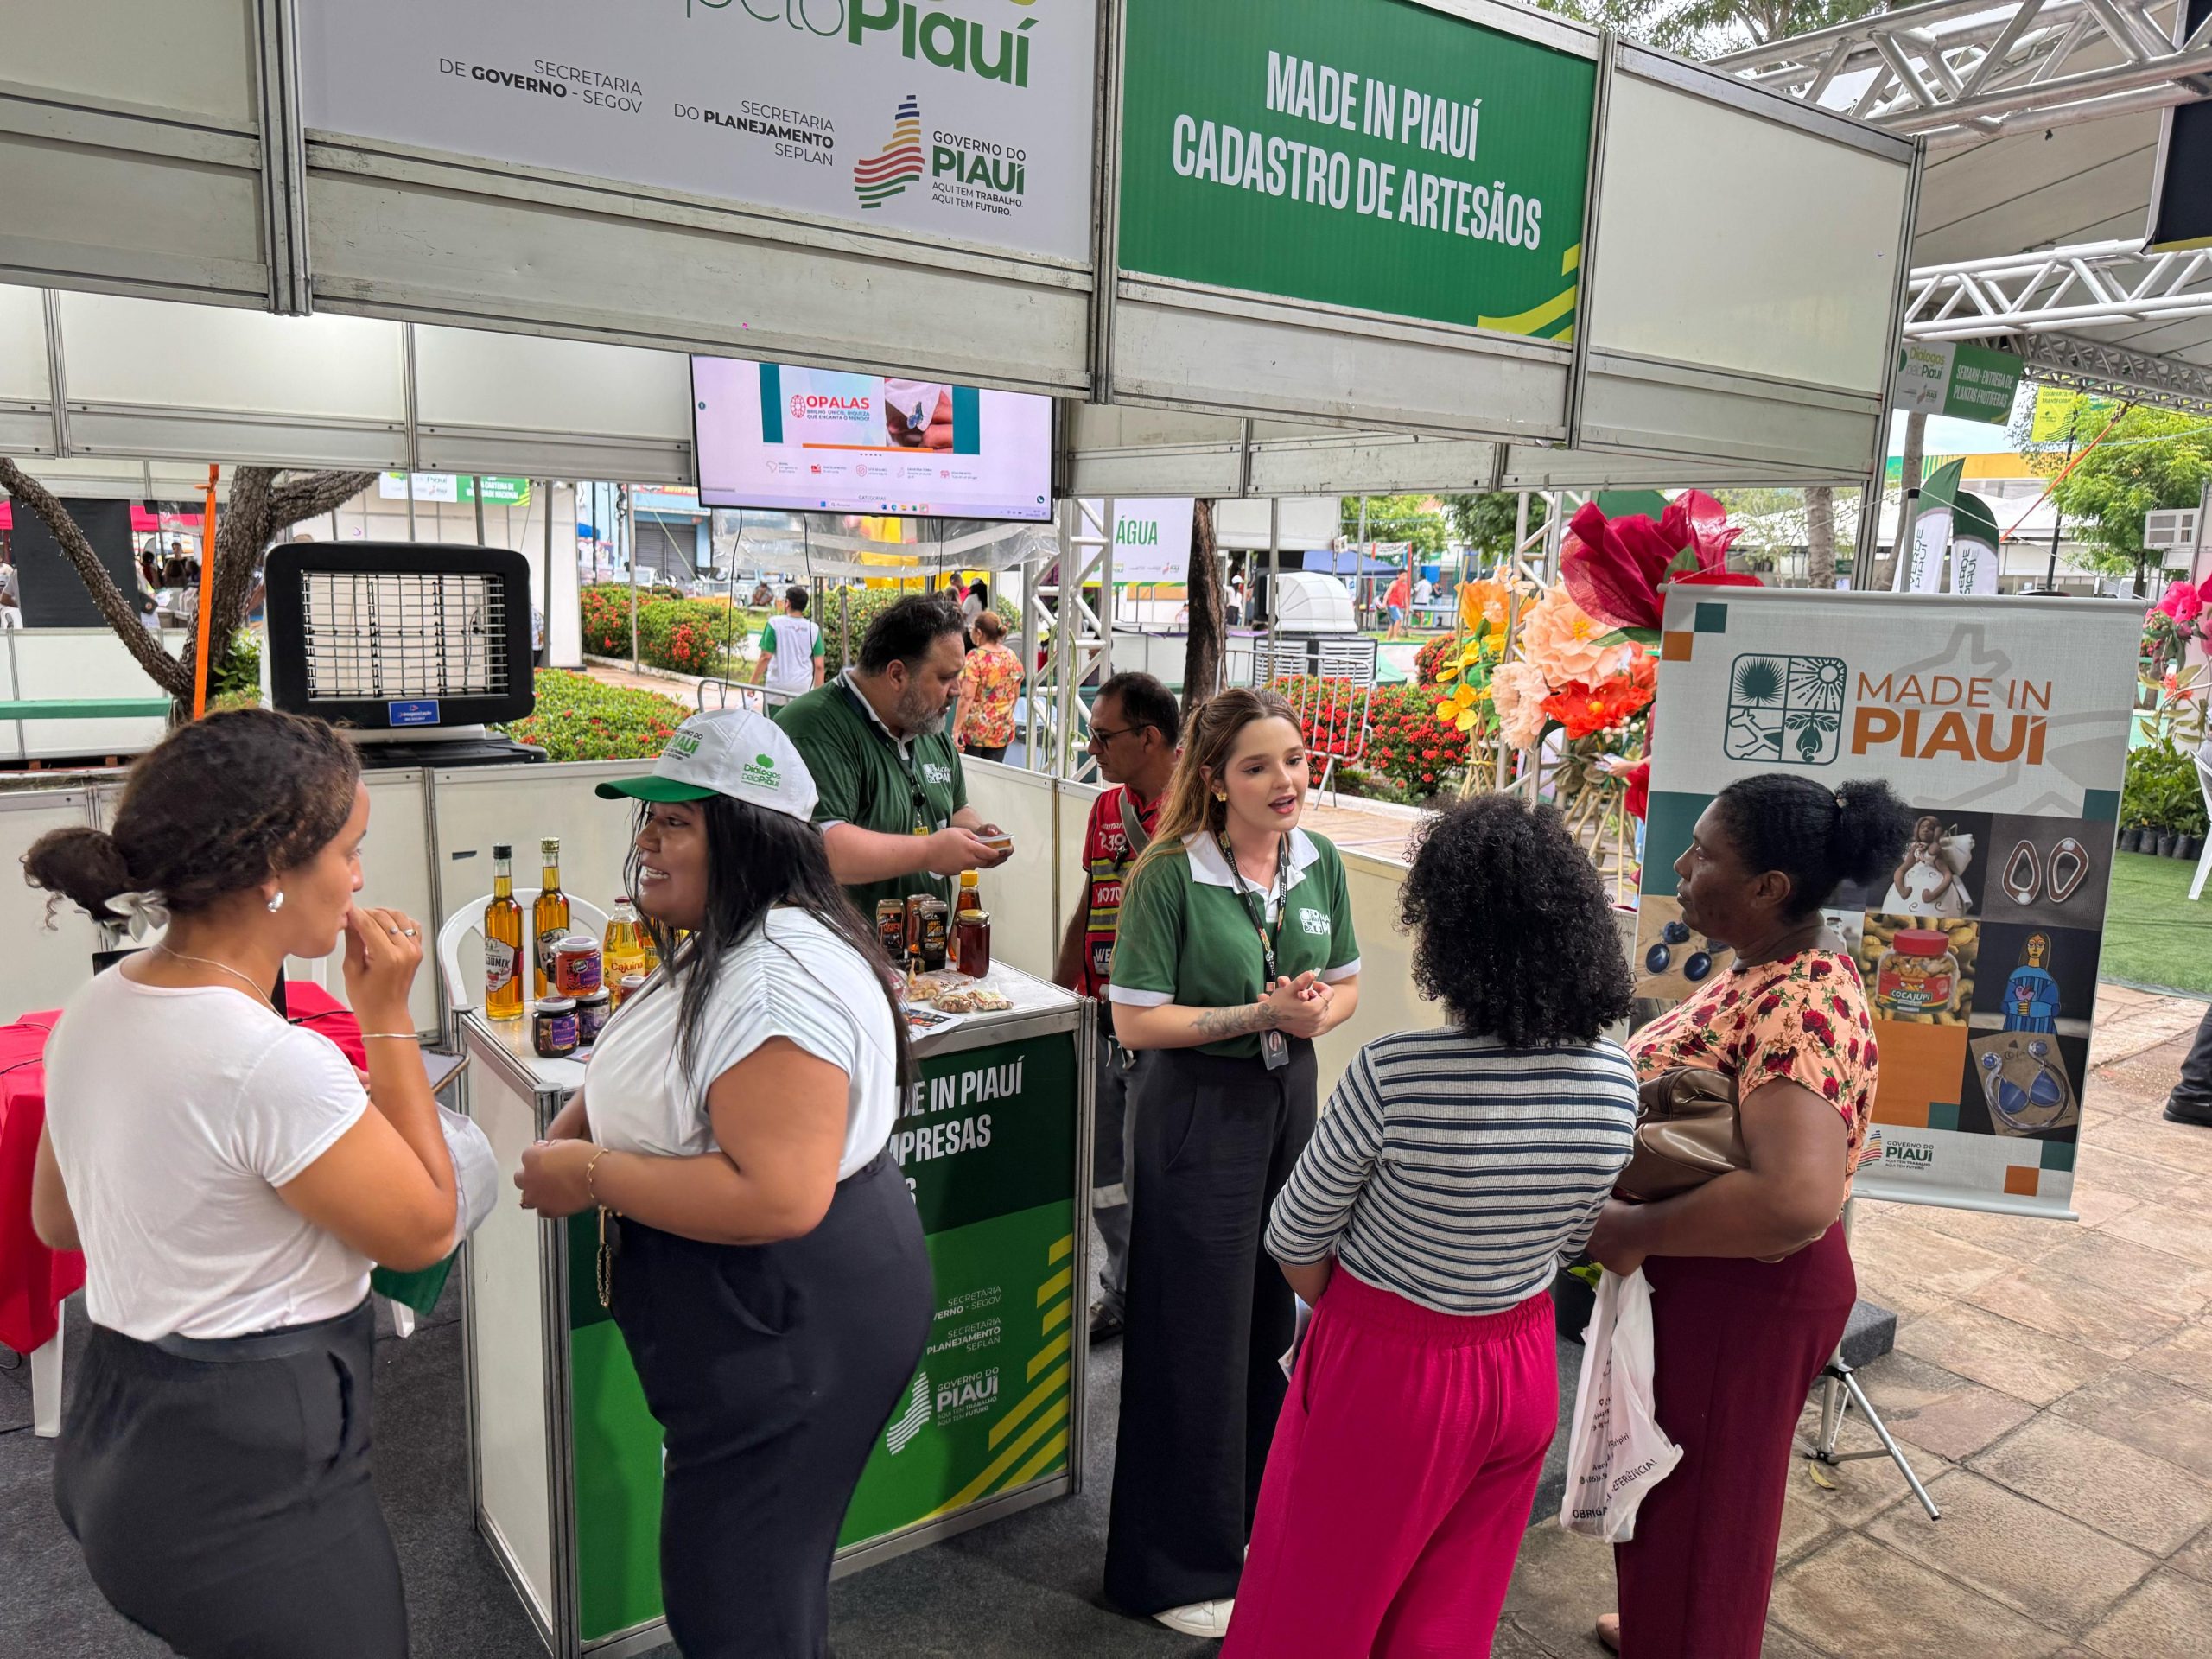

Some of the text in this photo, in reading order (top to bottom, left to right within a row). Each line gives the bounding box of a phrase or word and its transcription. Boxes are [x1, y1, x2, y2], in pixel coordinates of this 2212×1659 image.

[439, 58, 466, 78] DE
[471, 66, 567, 98] GOVERNO
[582, 89, 642, 113] SEGOV
[534, 60, 642, 96] SECRETARIA
[741, 100, 835, 132] SECRETARIA
[1266, 50, 1483, 162] MADE IN PIAUÍ
[674, 103, 834, 149] DO PLANEJAMENTO
[774, 143, 833, 167] SEPLAN
[932, 130, 1026, 162] GOVERNO DO
[932, 144, 1025, 195] PIAUÍ
[1173, 113, 1542, 251] CADASTRO DE ARTESÃOS
[931, 181, 1024, 208] AQUI TEM TRABALHO.
[931, 193, 1012, 217] AQUI TEM FUTURO.
[1909, 346, 1945, 365] Diálogos
[1956, 365, 1980, 382] SEMARH
[1981, 370, 2006, 388] ENTREGA
[2005, 375, 2014, 389] DE
[806, 395, 870, 410] OPALAS
[1953, 384, 1976, 403] PLANTAS
[1115, 515, 1158, 545] ÁGUA
[1857, 671, 2052, 711] MADE IN
[1851, 706, 2048, 766] PIAUÍ
[743, 763, 781, 779] Diálogos
[1891, 989, 1931, 1001] COCAJUPI
[930, 1075, 956, 1113] IN
[961, 1055, 1025, 1106] PIAUÍ
[1885, 1146, 1933, 1162] PIAUÍ
[1886, 1141, 1922, 1149] GOVERNO
[948, 1285, 1001, 1307] SECRETARIA
[971, 1294, 1001, 1310] SEGOV
[926, 1326, 1001, 1355] PLANEJAMENTO
[947, 1316, 1001, 1339] SECRETARIA
[966, 1335, 1001, 1352] SEPLAN
[937, 1366, 999, 1392] GOVERNO DO
